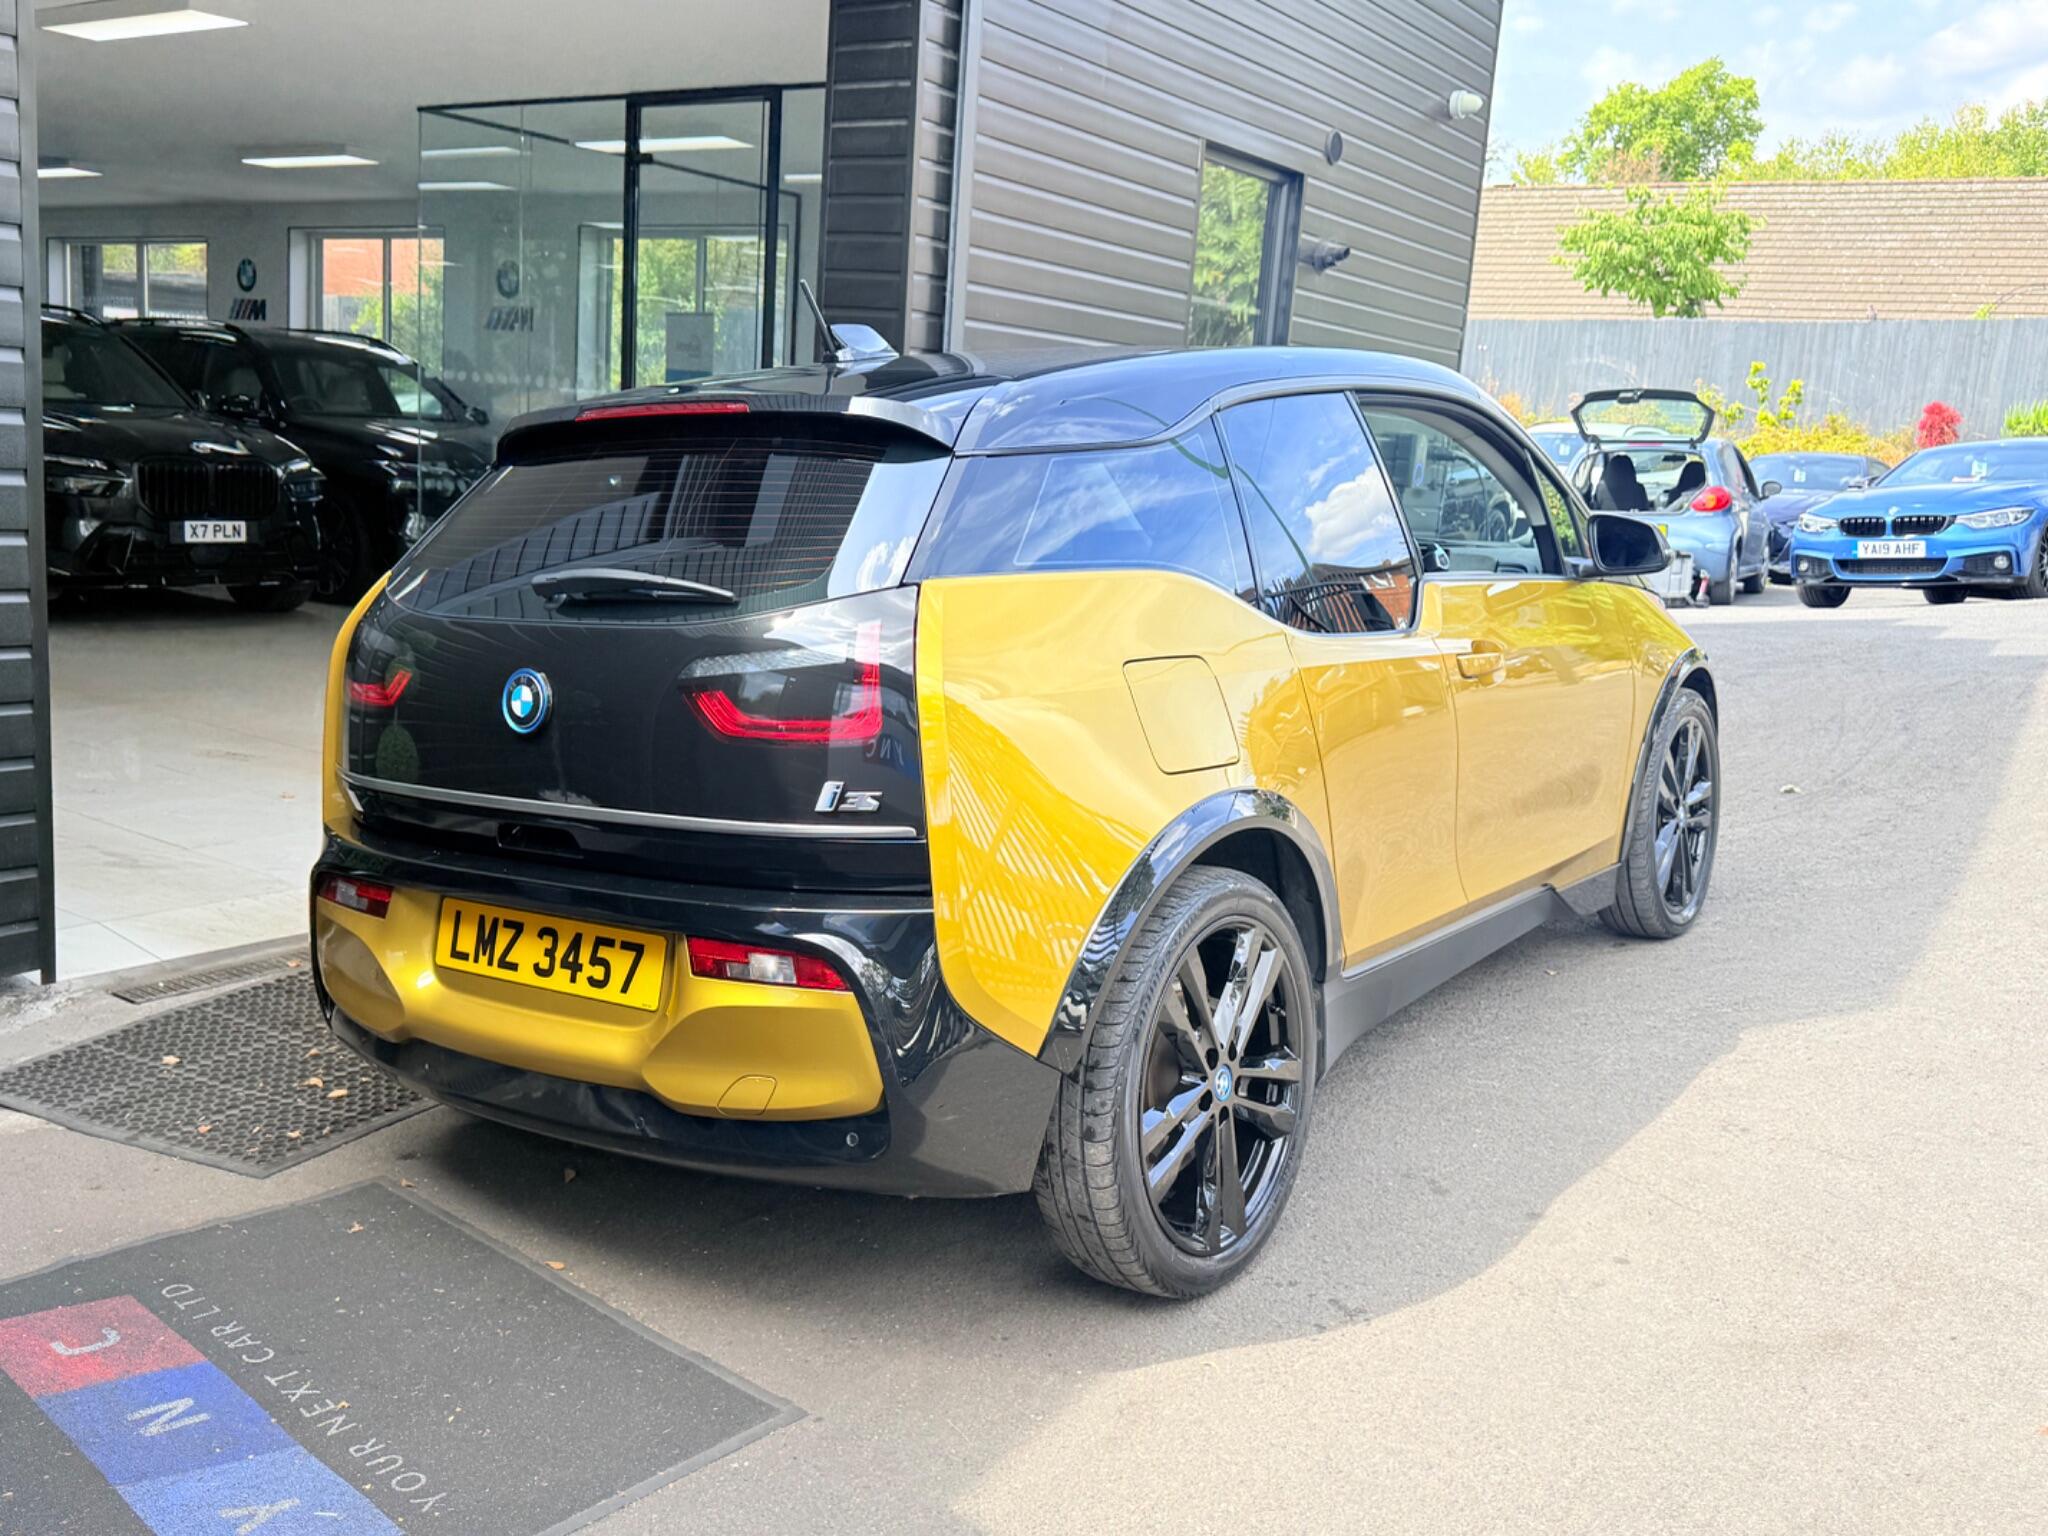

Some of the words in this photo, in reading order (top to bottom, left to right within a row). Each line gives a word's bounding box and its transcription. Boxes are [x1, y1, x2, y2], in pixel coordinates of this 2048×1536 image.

[190, 523, 208, 538] X7
[213, 523, 242, 538] PLN
[1862, 542, 1890, 555] YA19
[1894, 542, 1920, 555] AHF
[450, 909, 525, 972] LMZ
[532, 926, 645, 995] 3457
[161, 1283, 222, 1322] LTD
[210, 1319, 275, 1364] CAR
[264, 1369, 357, 1437] NEXT
[349, 1438, 447, 1513] YOUR
